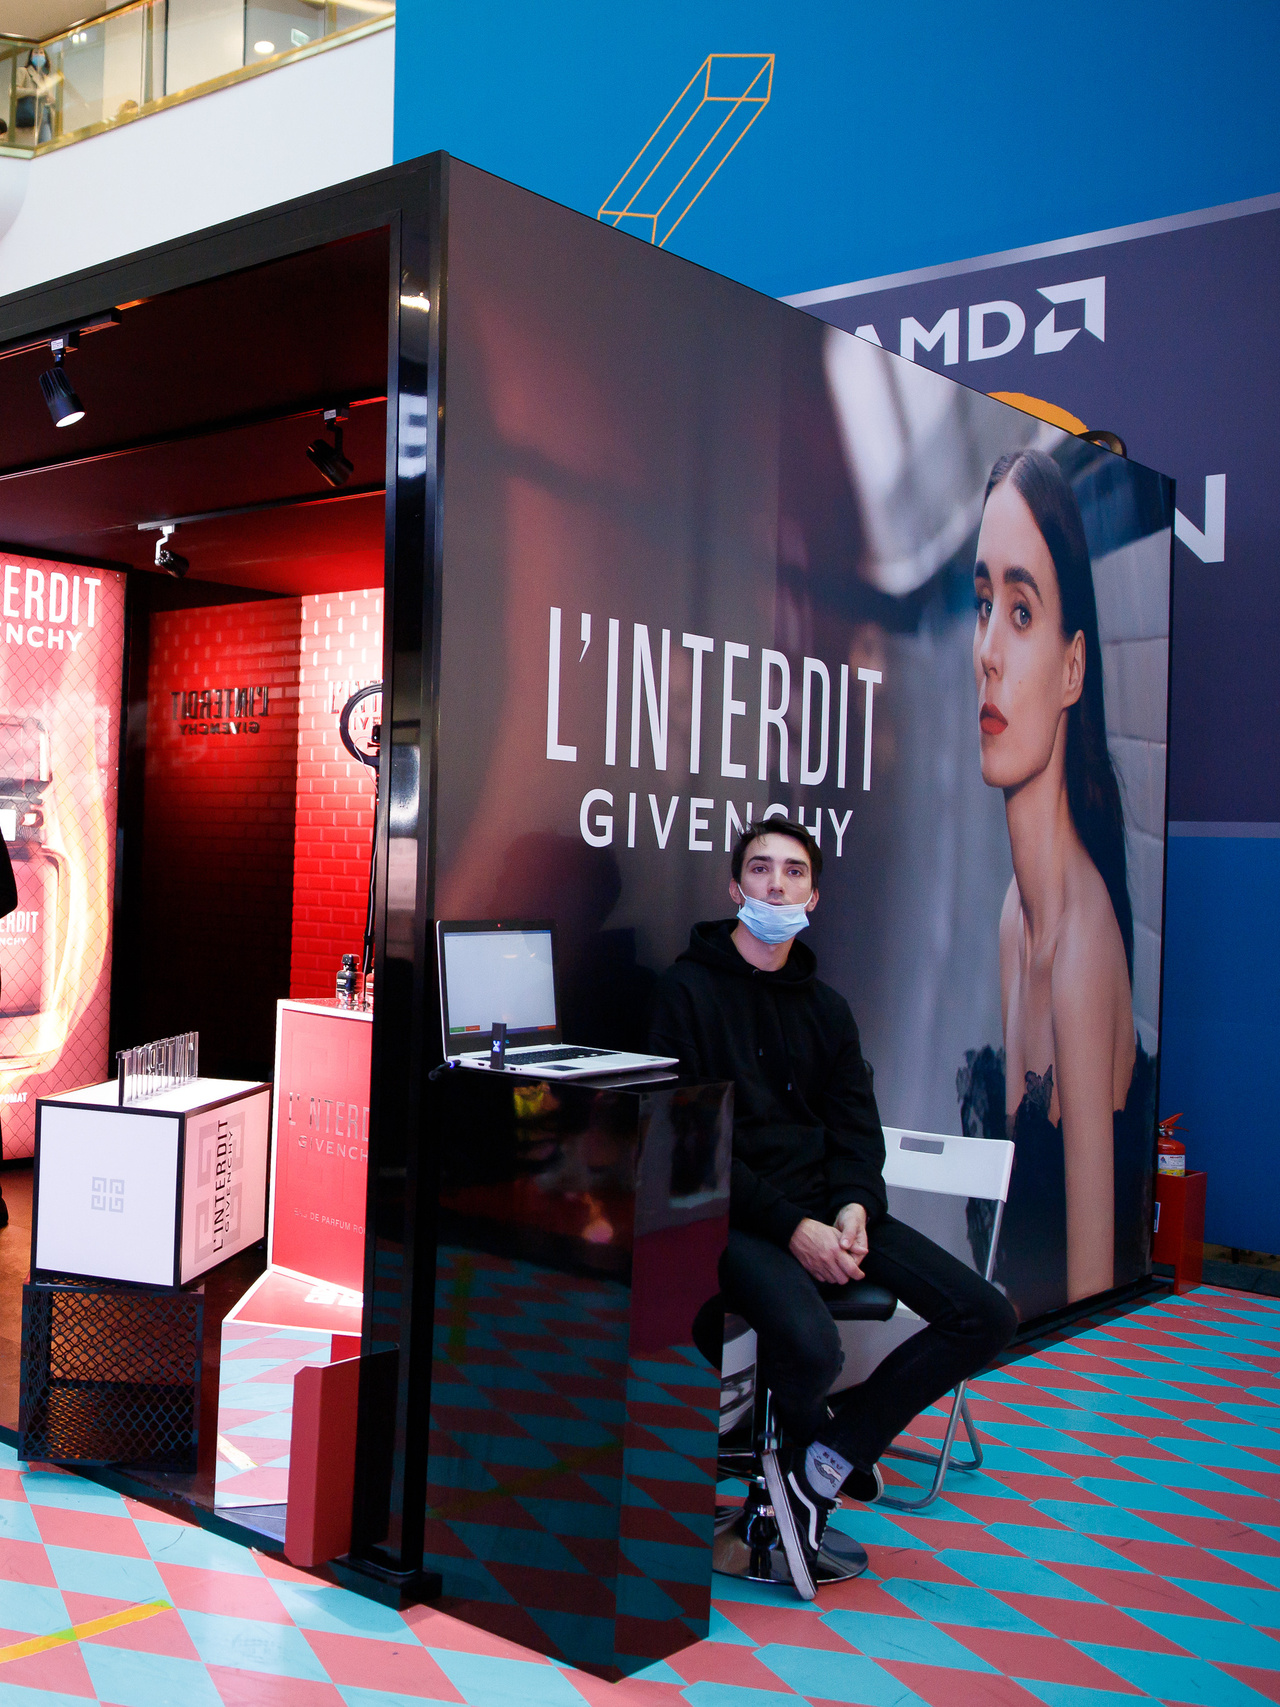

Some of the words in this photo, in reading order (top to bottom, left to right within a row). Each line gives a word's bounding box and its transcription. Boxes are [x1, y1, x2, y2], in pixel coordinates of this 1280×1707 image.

[546, 606, 883, 791] L'INTERDIT
[213, 1120, 228, 1253] L'INTERDIT
[225, 1131, 233, 1232] GIVENCHY
[298, 1135, 368, 1163] GIVENCH
[310, 1212, 320, 1222] DE
[321, 1215, 351, 1230] PARFUM
